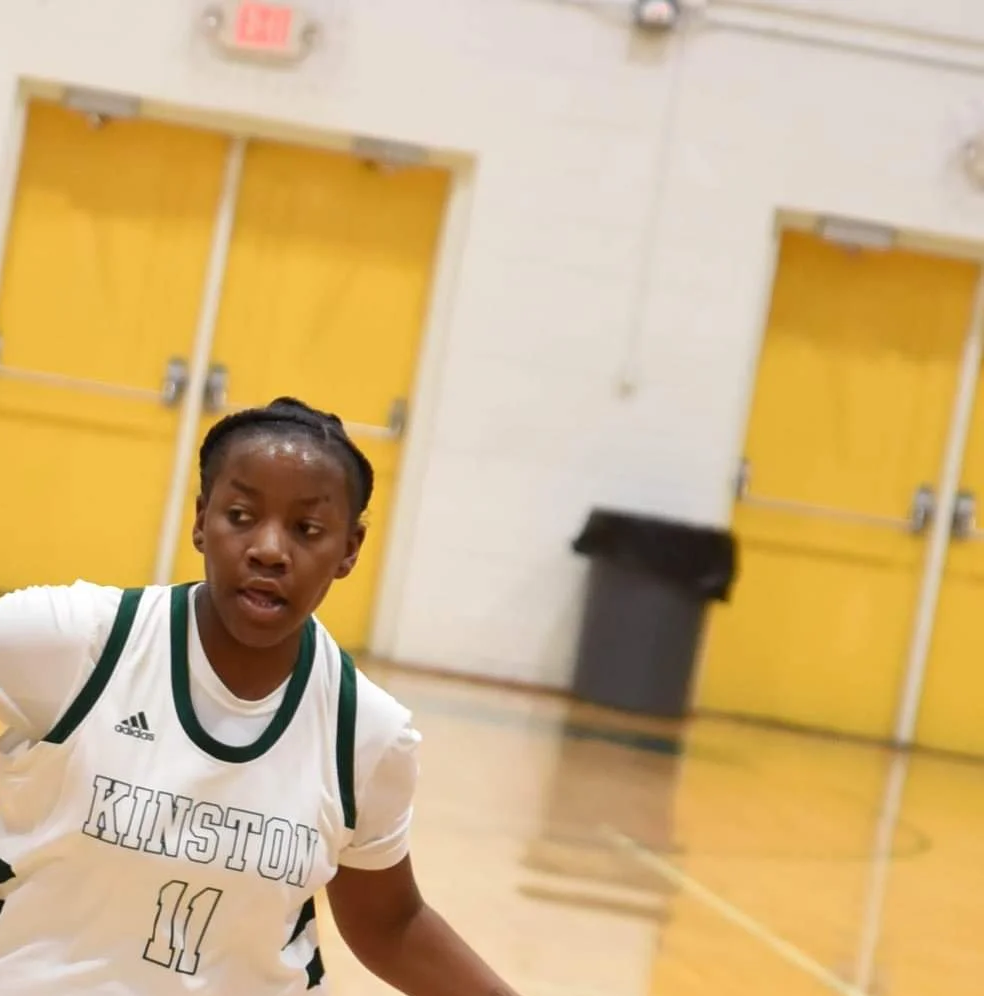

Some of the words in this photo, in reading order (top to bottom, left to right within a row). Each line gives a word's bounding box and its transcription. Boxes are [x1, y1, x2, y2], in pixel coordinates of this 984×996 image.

[114, 724, 155, 741] adidas
[82, 774, 318, 888] KINSTON
[142, 880, 223, 975] 11
